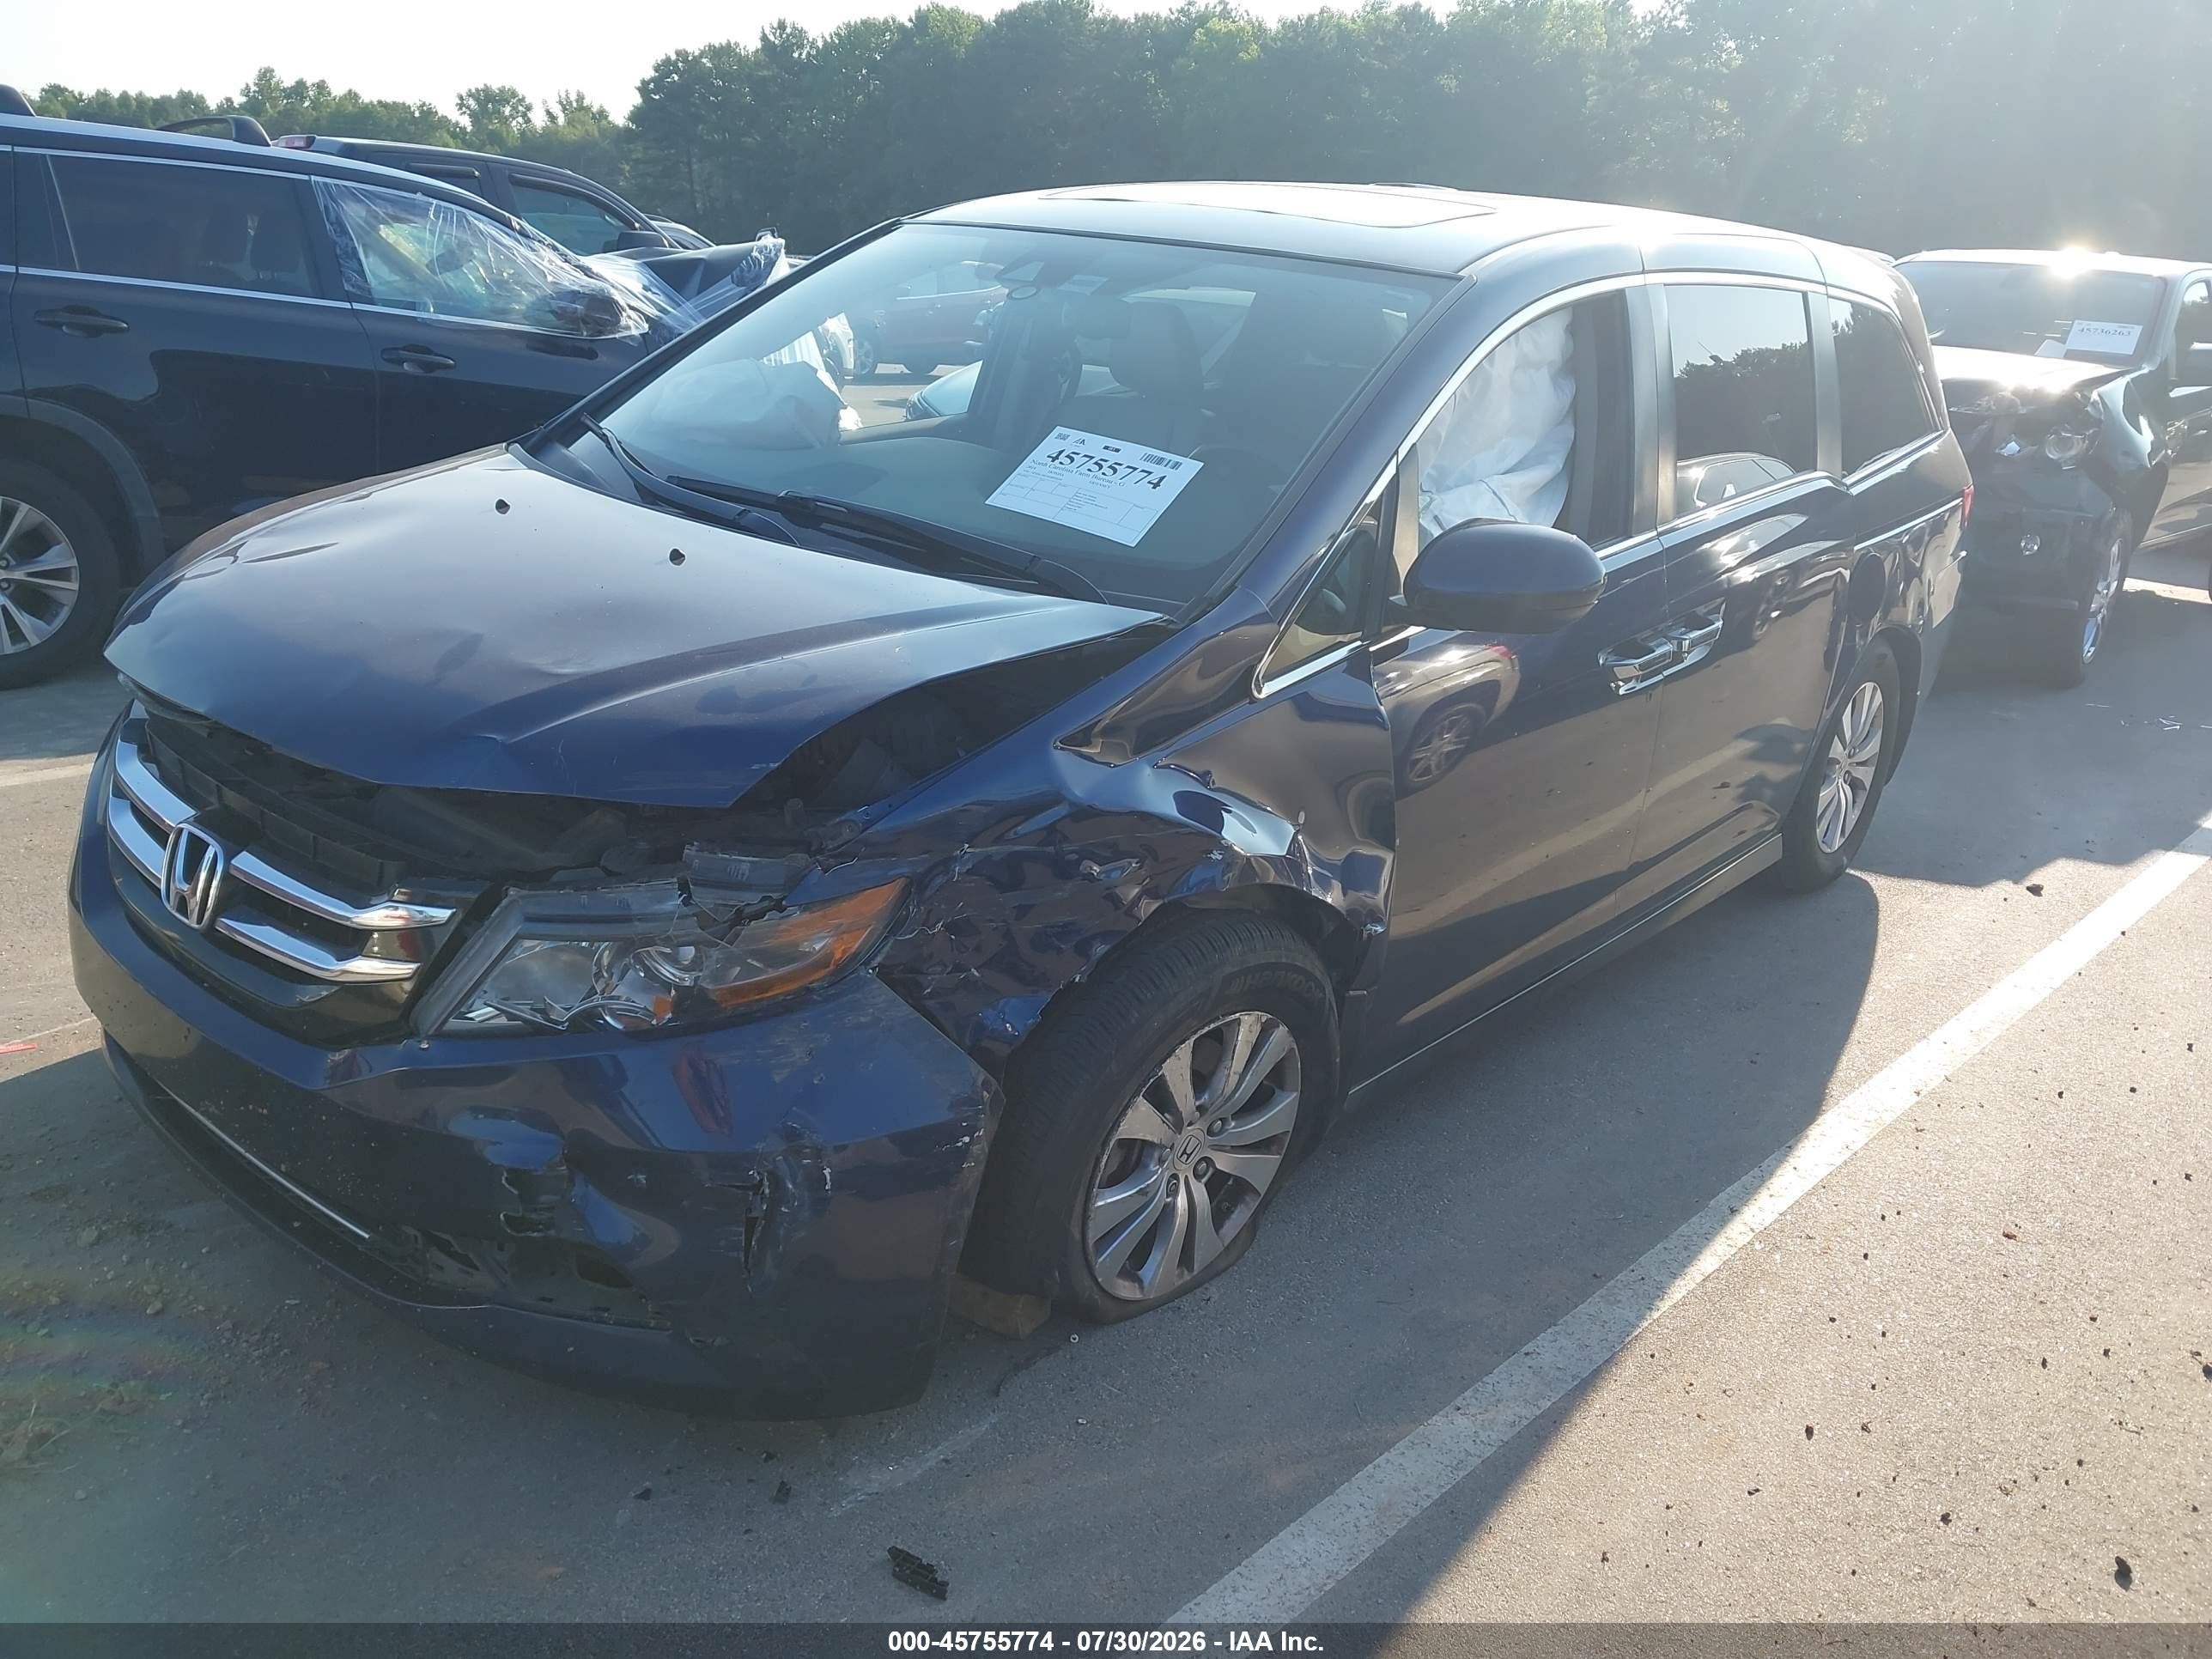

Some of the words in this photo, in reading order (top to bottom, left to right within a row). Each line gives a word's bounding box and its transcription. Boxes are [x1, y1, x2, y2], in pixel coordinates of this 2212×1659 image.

[1030, 459, 1048, 468] North
[1048, 463, 1073, 474] Carolina
[1074, 470, 1091, 478] Farm
[1091, 473, 1114, 485] Bureau
[1046, 448, 1167, 489] 45755774
